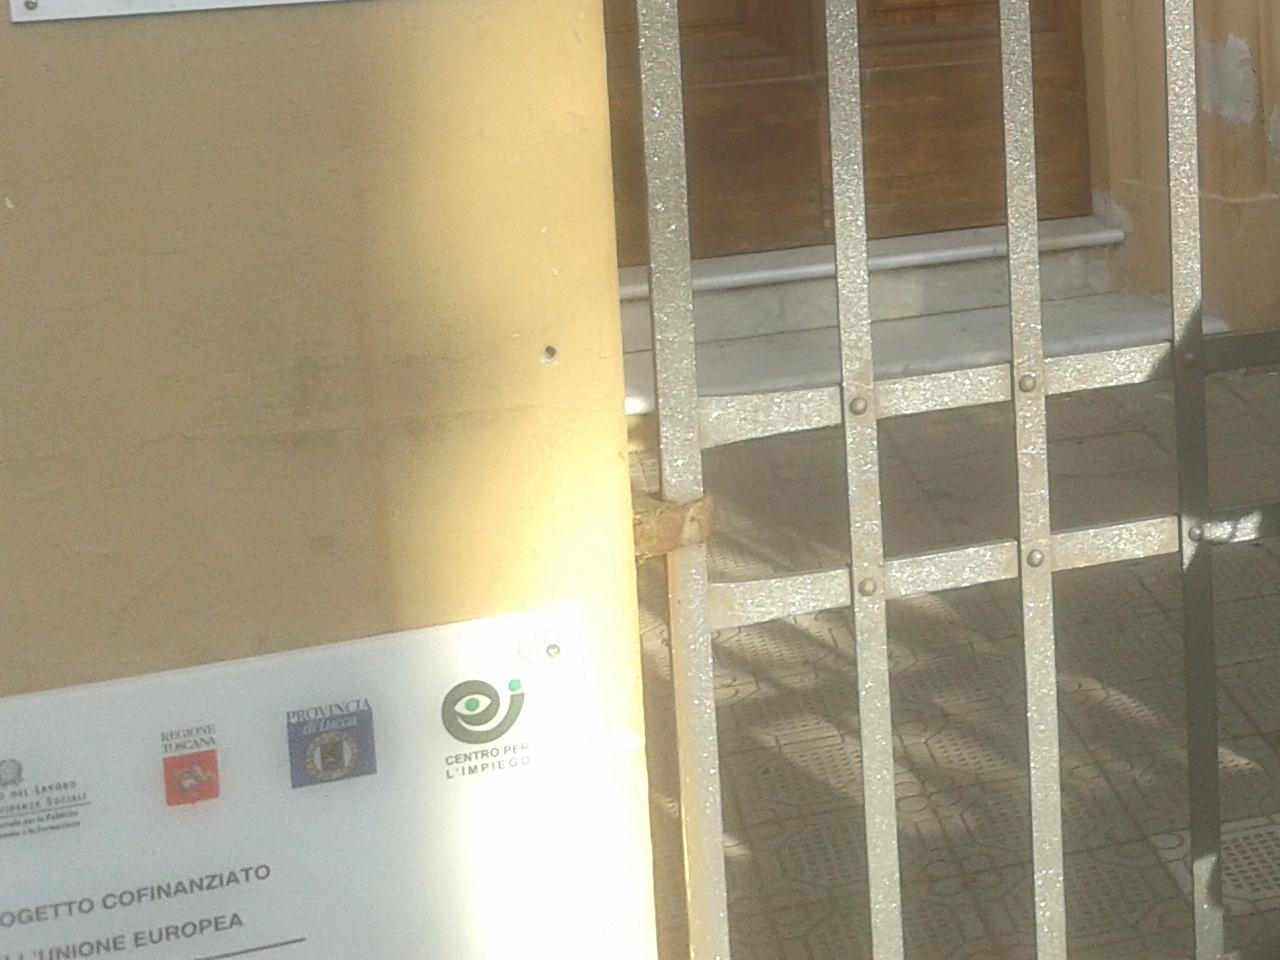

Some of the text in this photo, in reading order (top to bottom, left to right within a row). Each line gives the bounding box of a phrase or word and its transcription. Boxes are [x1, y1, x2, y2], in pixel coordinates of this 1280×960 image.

[286, 697, 373, 724] PROVINCIA
[161, 724, 215, 743] REGIONE
[161, 737, 217, 754] TOSCANA
[445, 743, 530, 766] CENTRO PER
[446, 756, 531, 780] L'IMPIEGO
[102, 864, 271, 911] COFINANZIATO
[134, 913, 244, 947] EUROPEA
